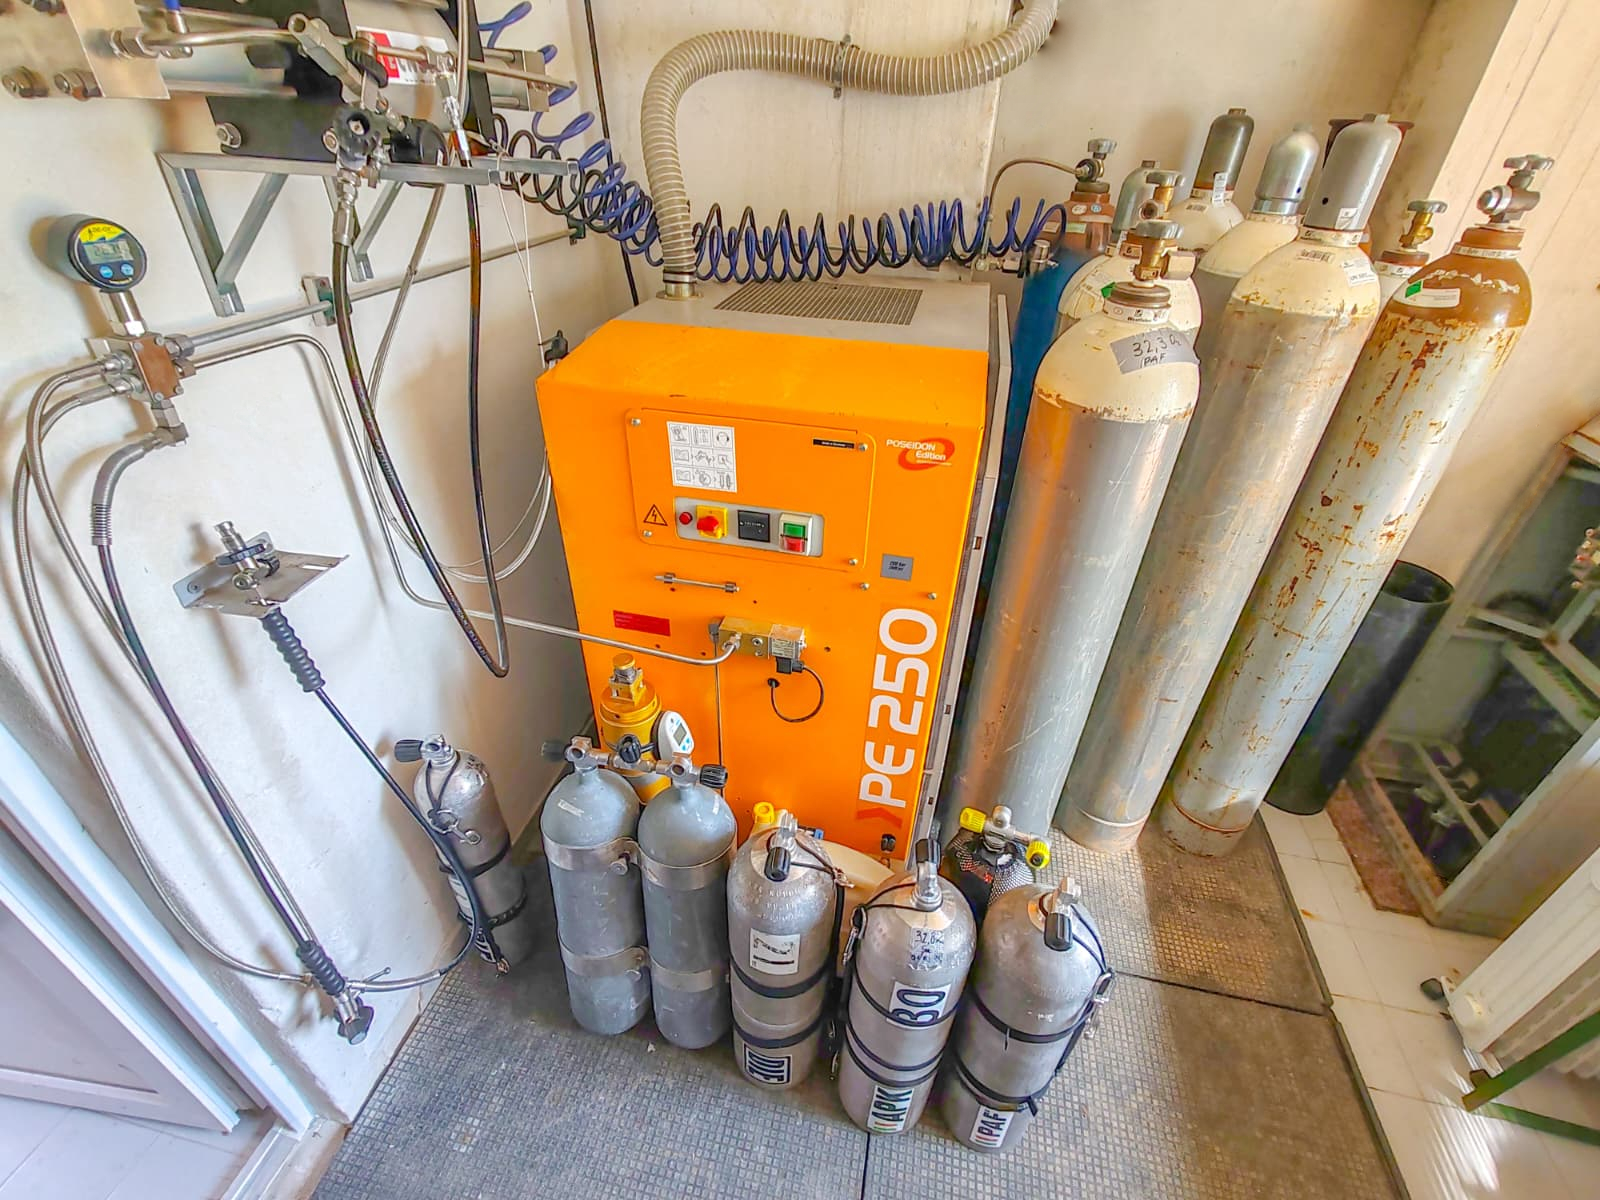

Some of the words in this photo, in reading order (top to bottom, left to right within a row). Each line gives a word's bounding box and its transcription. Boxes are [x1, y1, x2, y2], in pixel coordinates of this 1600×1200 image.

[1132, 337, 1167, 357] 32,3
[886, 439, 936, 451] POSEIDON
[915, 450, 947, 461] Edition
[868, 608, 938, 735] 250
[859, 741, 915, 808] PE
[871, 1087, 913, 1122] APK
[977, 1109, 1008, 1137] PAF
